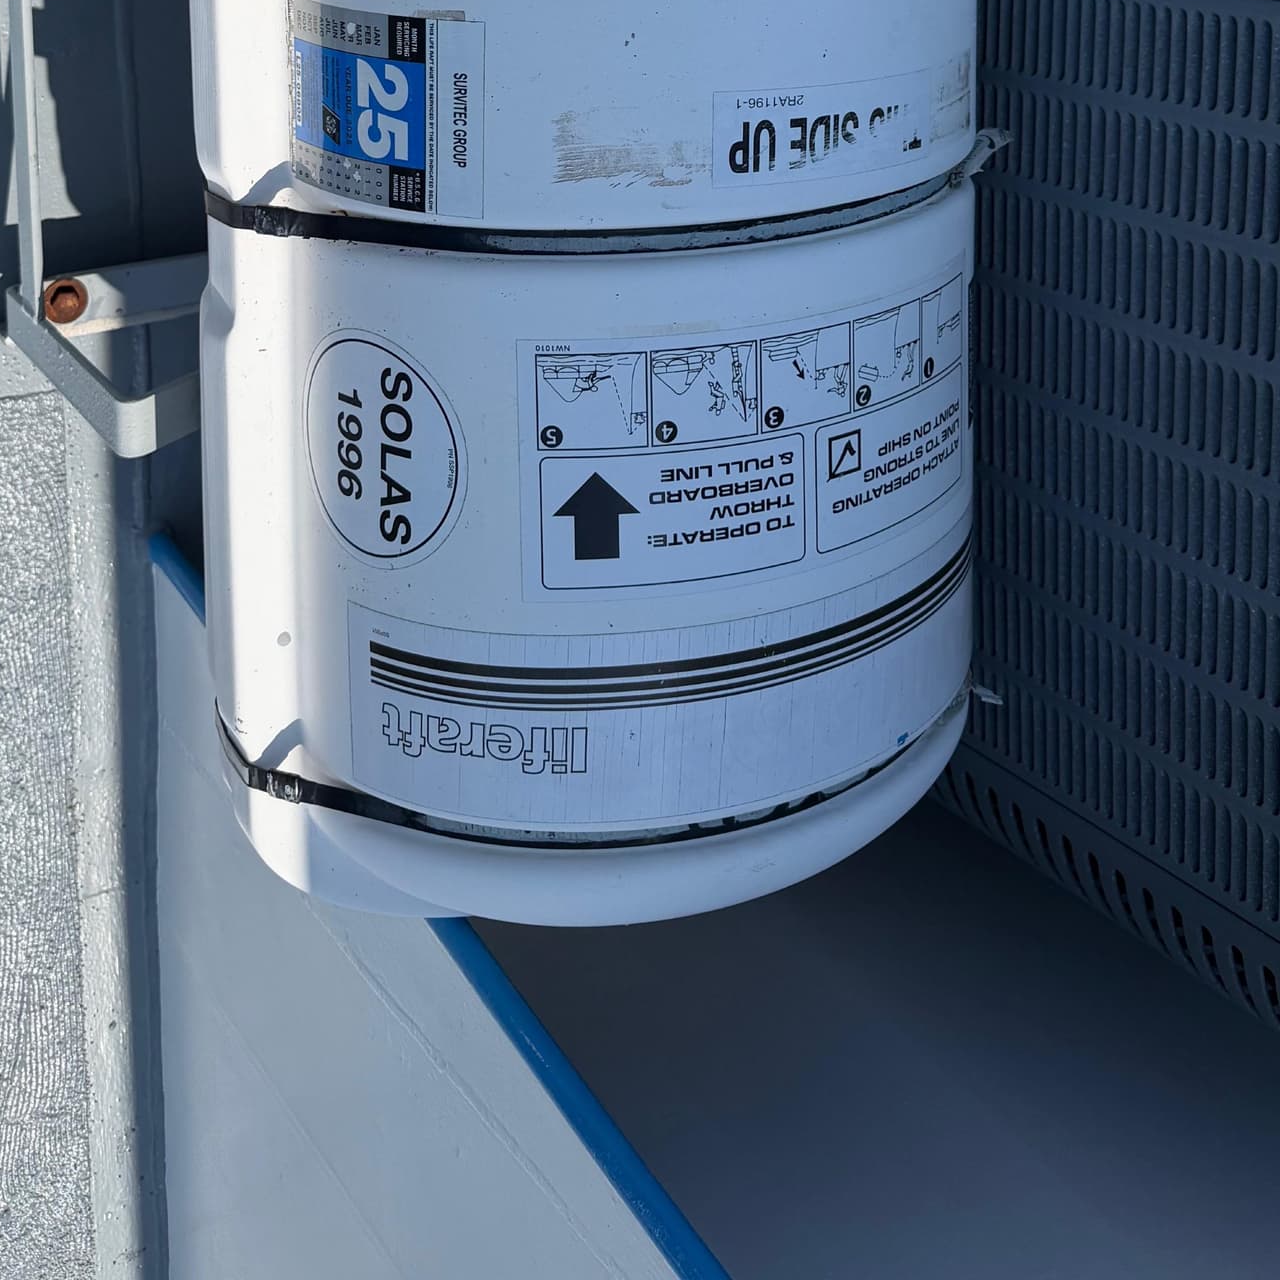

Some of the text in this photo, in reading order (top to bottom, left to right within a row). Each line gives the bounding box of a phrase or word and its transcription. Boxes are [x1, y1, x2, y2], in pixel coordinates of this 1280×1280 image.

[332, 19, 340, 39] JUN
[339, 21, 347, 42] MAY
[364, 25, 372, 45] FEB
[373, 26, 382, 46] JAN
[396, 22, 404, 56] REQUIRED
[403, 21, 411, 57] SERVICING
[356, 58, 410, 161] 25
[736, 94, 805, 109] 2RA1196-1
[452, 72, 468, 169] SURVITEC GROUP
[729, 120, 776, 175] UP
[789, 112, 859, 171] SIDE
[392, 174, 400, 201] NUMBER
[399, 175, 407, 202] STATION
[406, 176, 414, 203] SERVICE
[535, 344, 572, 353] NW1010
[337, 388, 363, 501] 1996
[877, 398, 961, 457] POINT ON SHIP
[379, 367, 413, 545] SOLAS
[660, 451, 795, 483] & PULL LINE
[863, 418, 961, 483] LINE TO STRONG
[649, 473, 795, 505] OVERBOARD
[831, 438, 962, 515] ATTACH OPERATING
[710, 494, 796, 520] THROW
[647, 514, 796, 549] TO OPERATE:
[381, 702, 589, 776] liferaft
